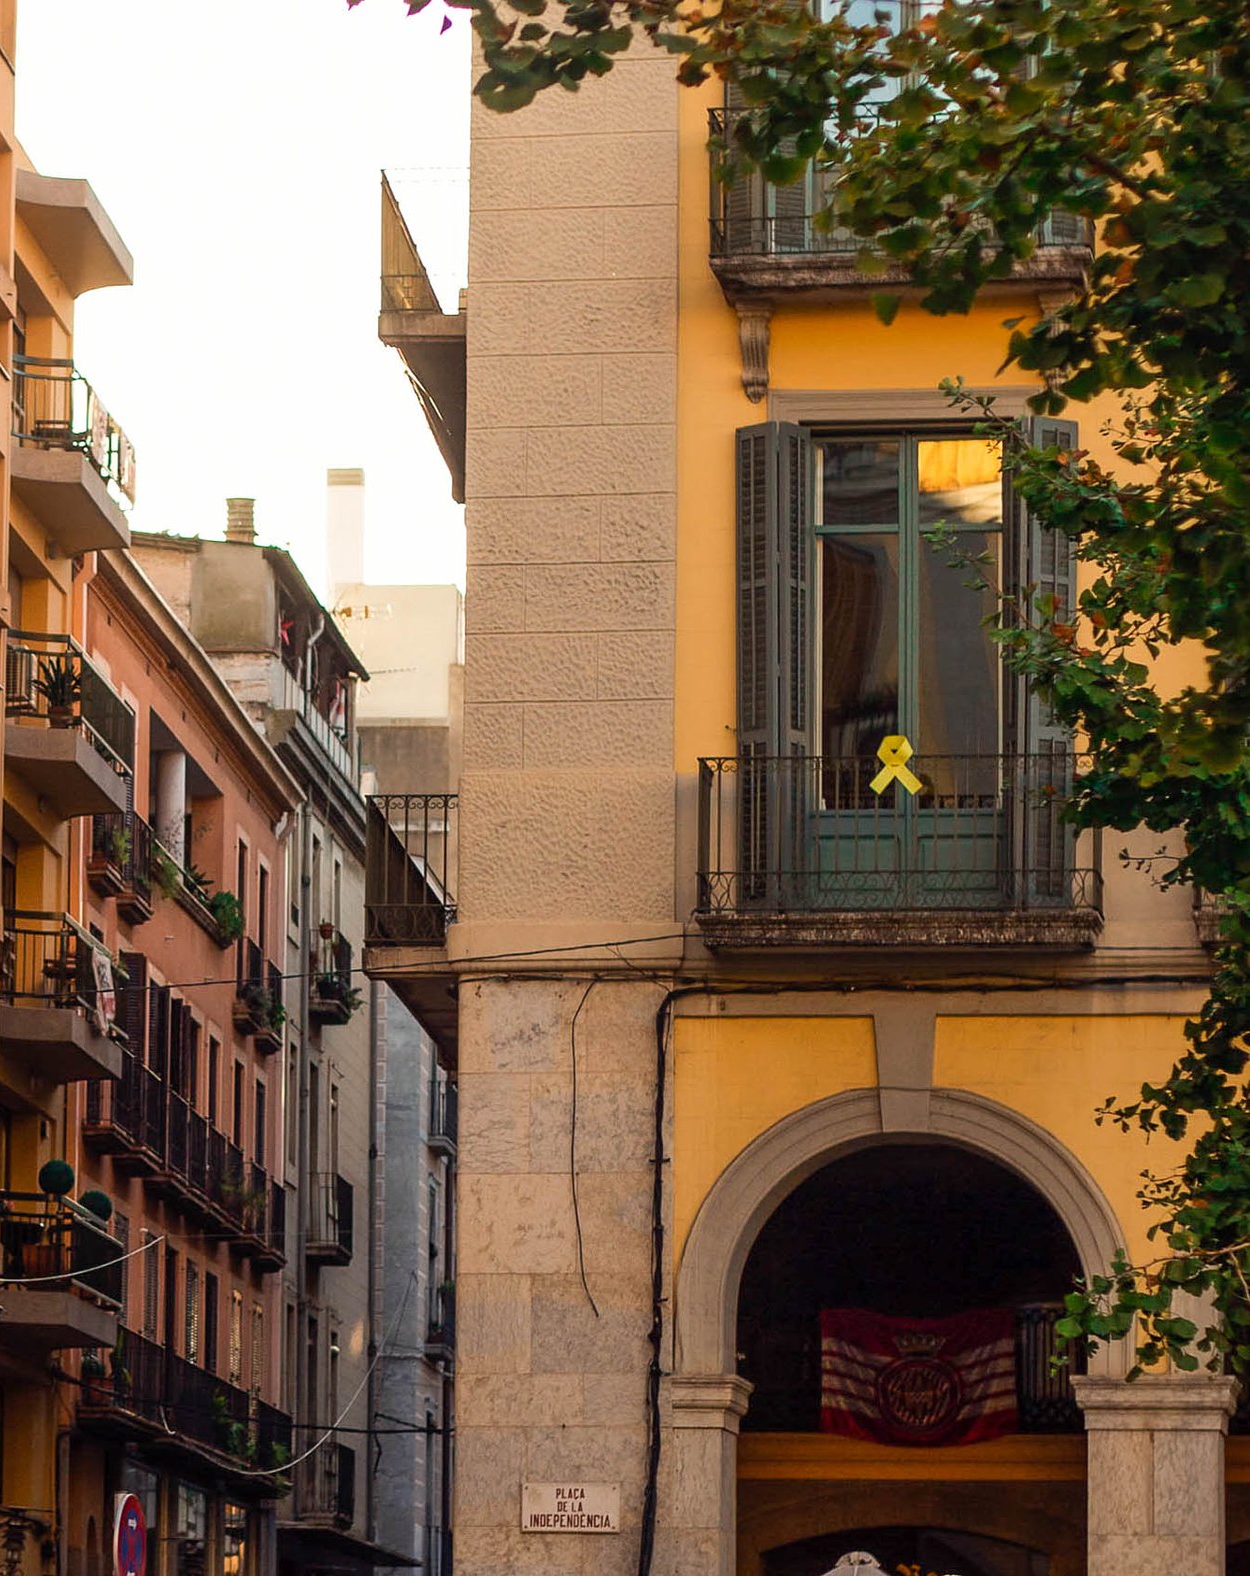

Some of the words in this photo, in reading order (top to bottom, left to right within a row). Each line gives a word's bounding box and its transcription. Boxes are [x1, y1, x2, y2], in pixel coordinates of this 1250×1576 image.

[555, 1488, 585, 1500] PLAÇA
[557, 1501, 568, 1512] DE
[571, 1501, 583, 1512] LA
[530, 1513, 611, 1528] INDEPENDÈNCIA
